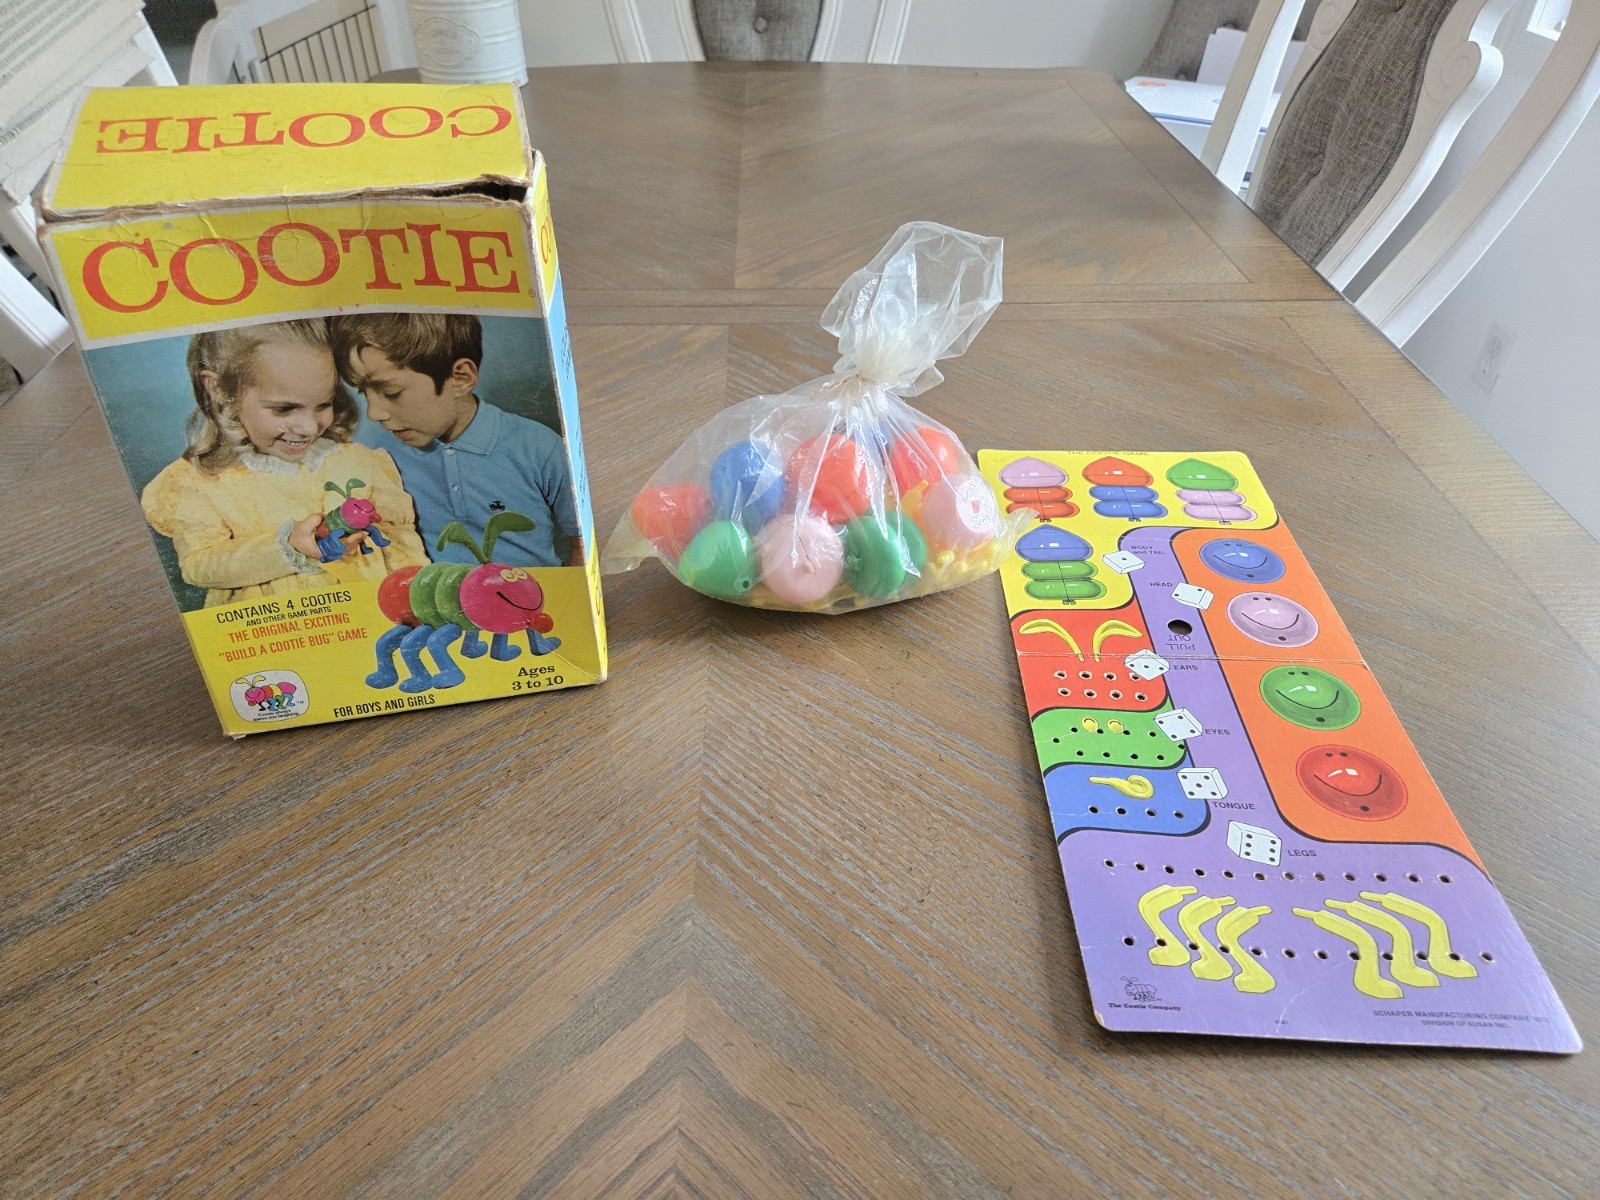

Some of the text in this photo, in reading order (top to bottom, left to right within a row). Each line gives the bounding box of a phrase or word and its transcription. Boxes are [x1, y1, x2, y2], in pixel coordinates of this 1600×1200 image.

[97, 105, 512, 154] COOTIE
[82, 222, 521, 313] COOTIE
[216, 590, 352, 625] CONTAINS 4 COOTIES
[246, 606, 332, 628] AND OTHER GAME PARTS
[228, 612, 350, 644] THE ORIGINAL EXCITING
[260, 644, 268, 655] A
[270, 638, 306, 654] COOTIE
[338, 627, 368, 643] GAME
[1166, 643, 1196, 651] PULL
[517, 665, 556, 679] Ages
[512, 675, 564, 691] 3 to 10
[333, 694, 436, 718] FOR BOYS AND GIRLS
[1204, 728, 1231, 736] EYES
[1211, 801, 1256, 810] TONGUE
[1287, 849, 1317, 858] LEGS
[1148, 1003, 1181, 1012] Company
[1373, 1010, 1413, 1018] SCHAPER
[1415, 1010, 1487, 1020] MANUFACTURING
[1489, 1013, 1530, 1022] COMPANY
